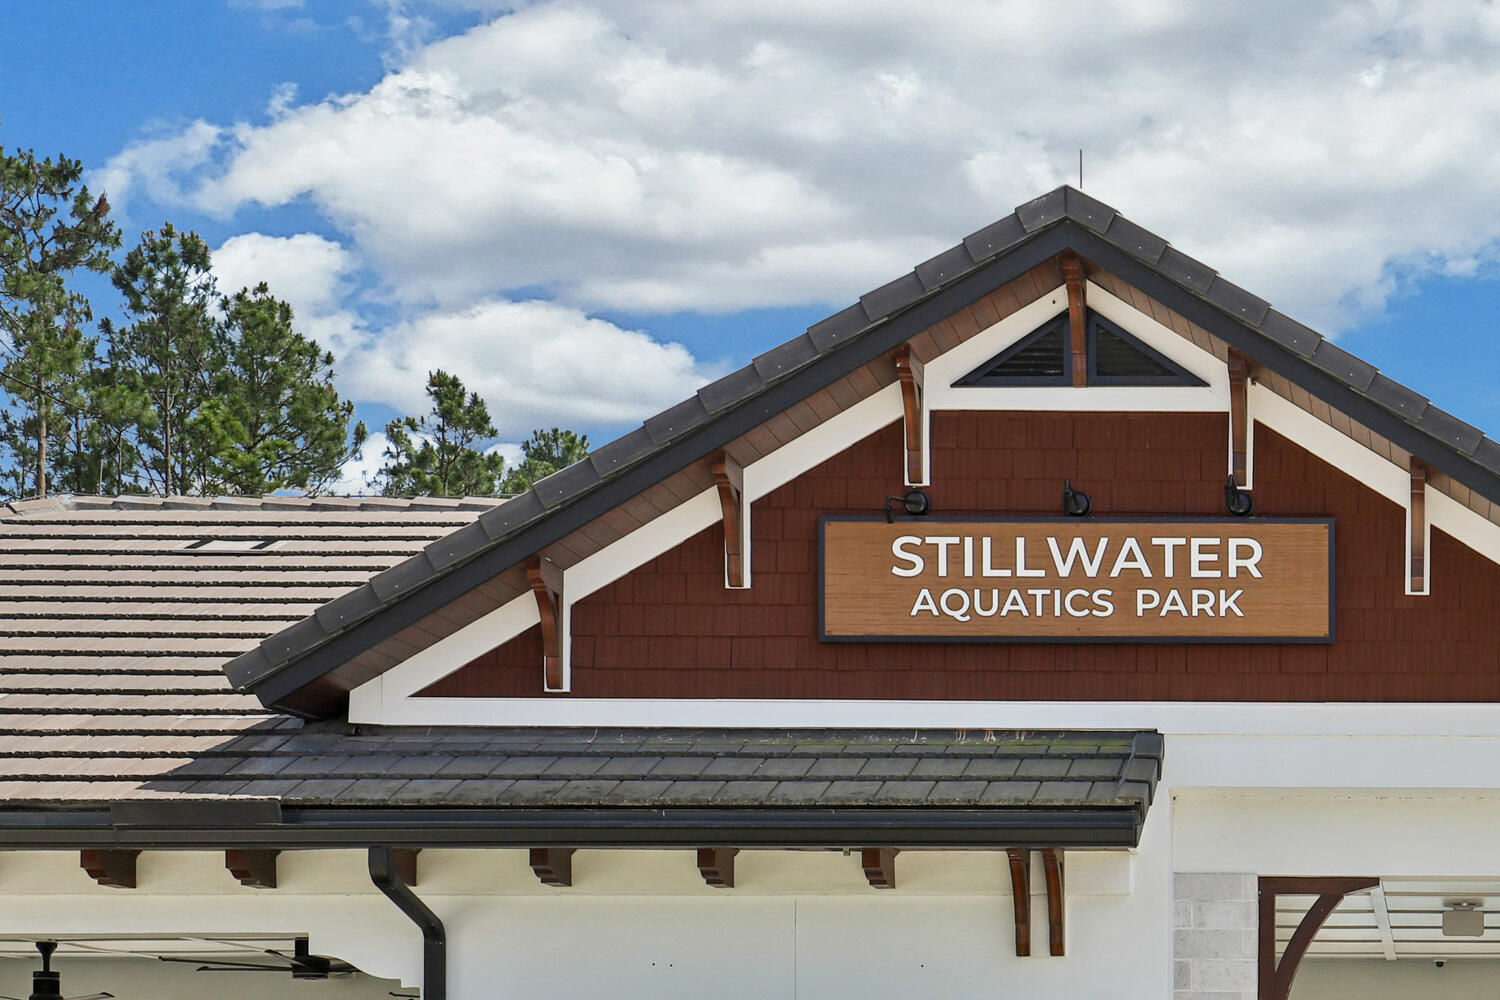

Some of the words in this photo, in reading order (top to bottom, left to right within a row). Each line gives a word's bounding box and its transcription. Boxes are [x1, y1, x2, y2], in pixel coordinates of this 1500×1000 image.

[890, 535, 1264, 579] STILLWATER
[909, 588, 1115, 622] AQUATICS
[1136, 589, 1245, 617] PARK
